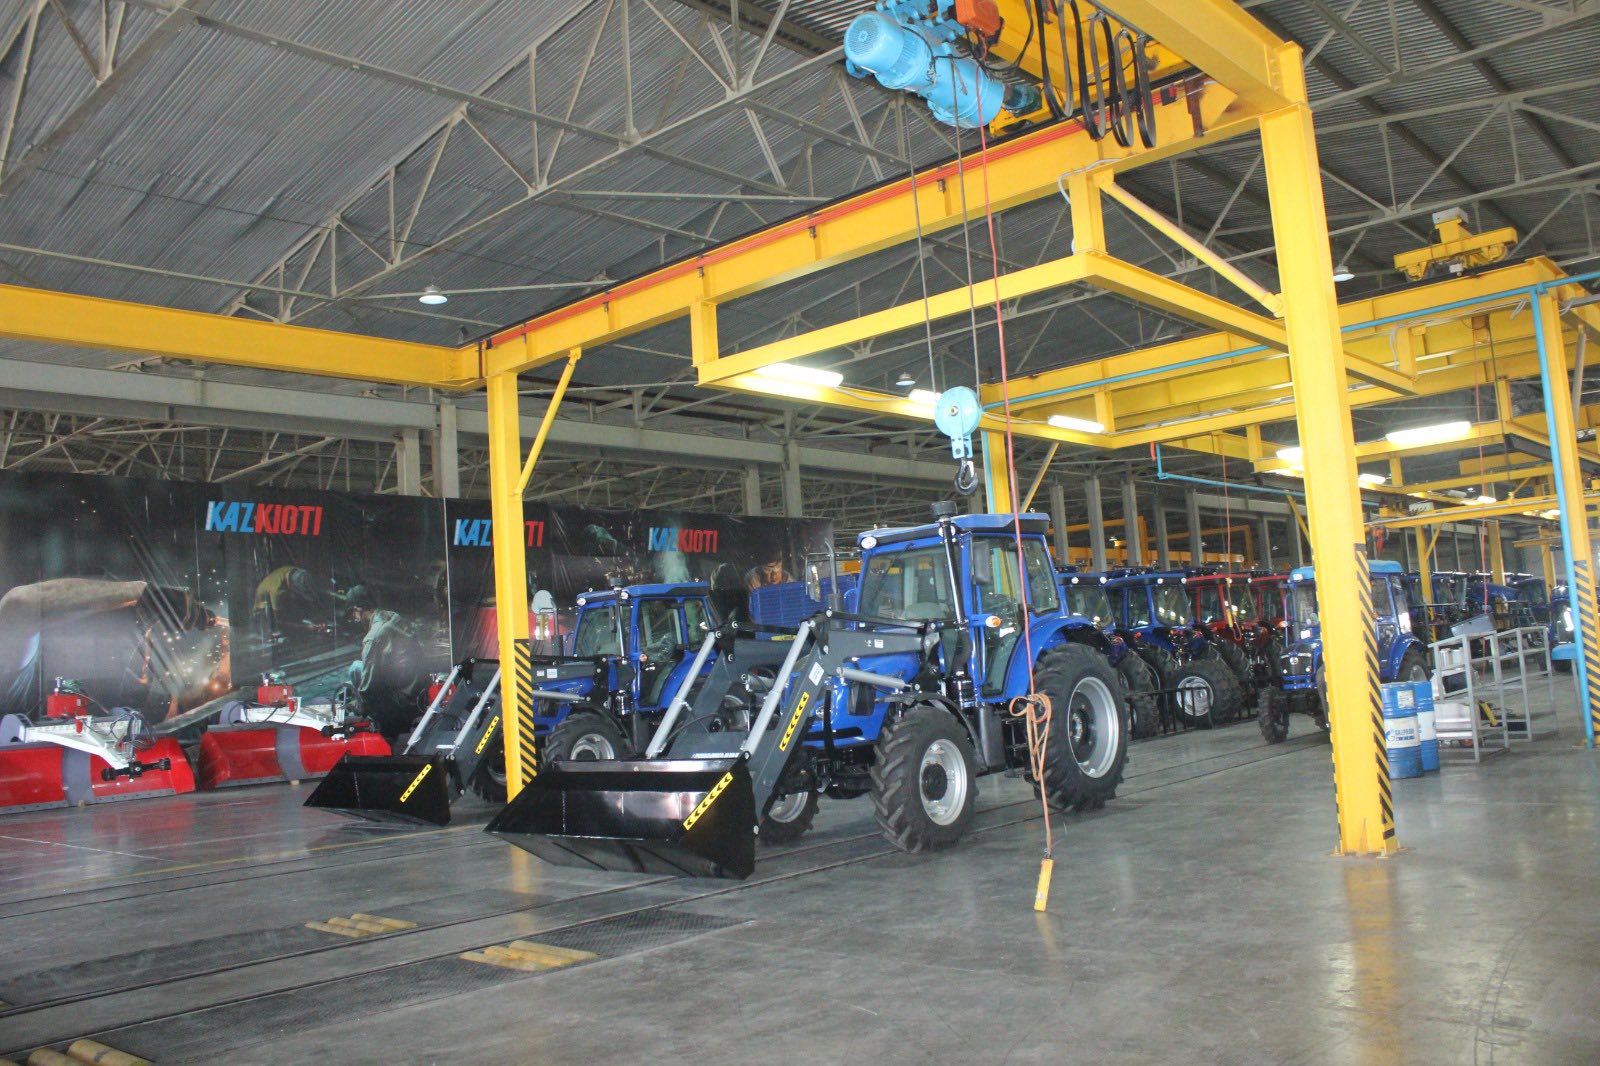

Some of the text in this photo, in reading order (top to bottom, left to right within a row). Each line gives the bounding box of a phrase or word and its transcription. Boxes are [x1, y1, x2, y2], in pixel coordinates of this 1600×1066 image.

[205, 500, 323, 536] KAZKIOTI
[453, 518, 545, 548] KAZTI
[648, 527, 718, 553] KAZKIOTI
